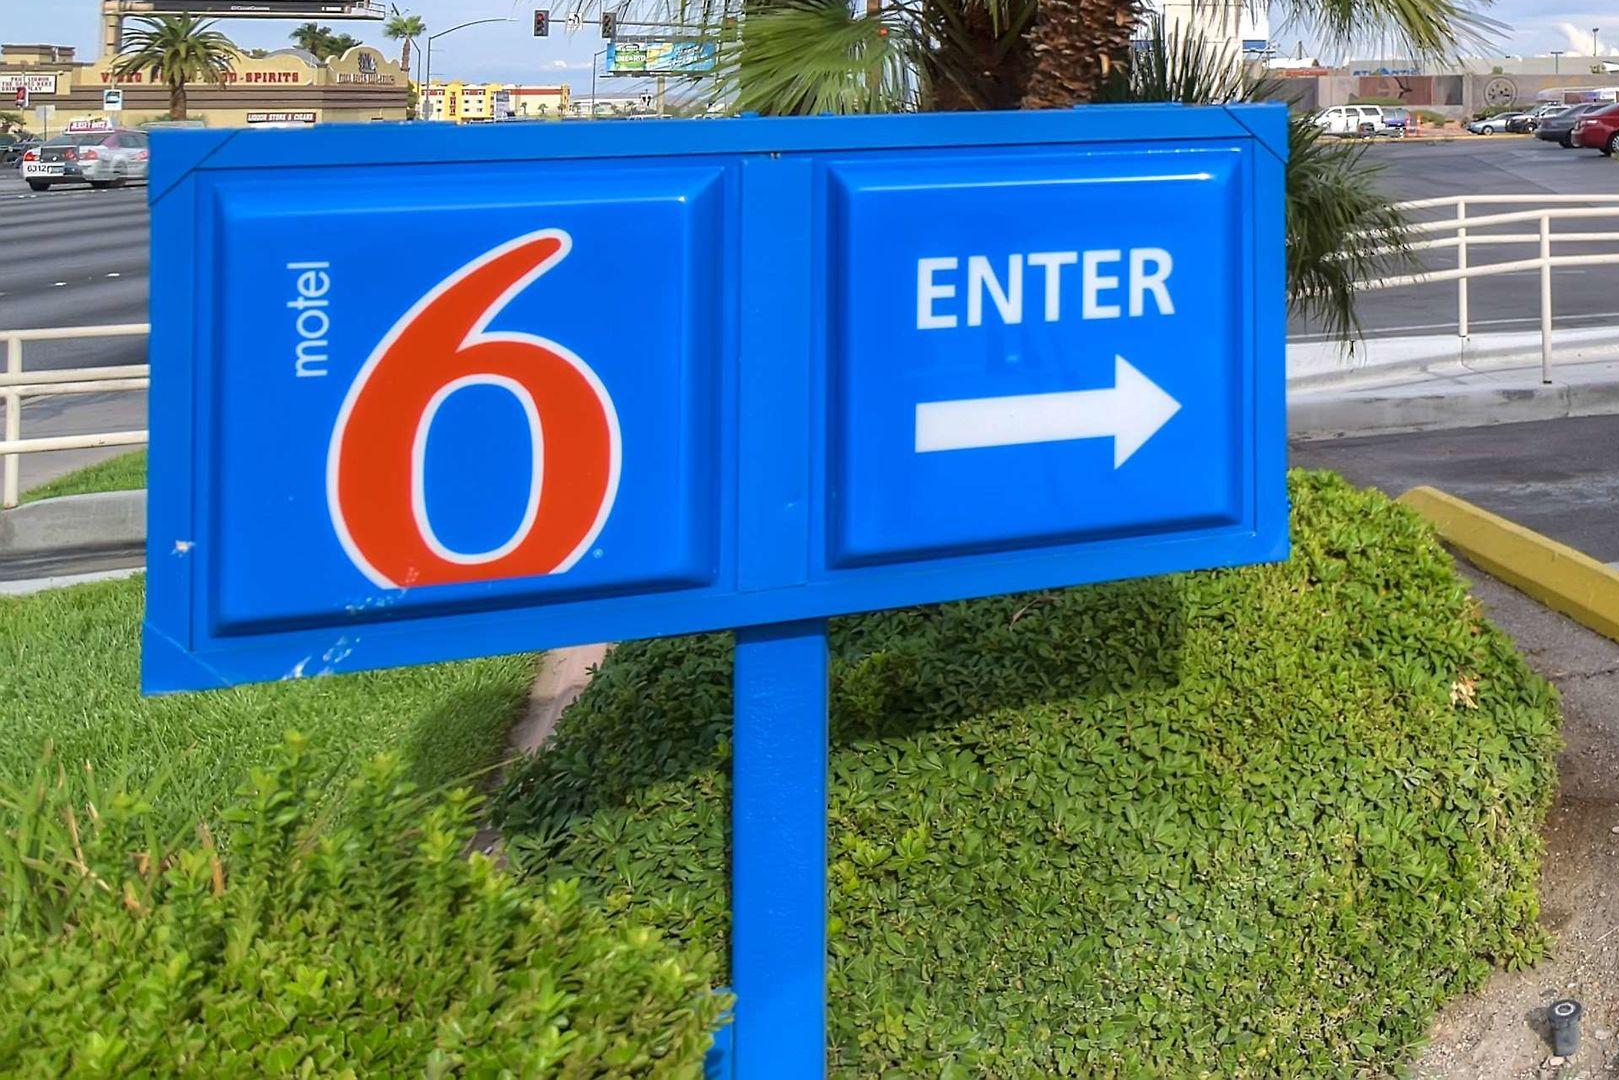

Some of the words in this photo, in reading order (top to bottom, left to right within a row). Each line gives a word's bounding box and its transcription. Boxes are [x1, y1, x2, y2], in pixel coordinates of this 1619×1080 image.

[245, 72, 300, 83] SPIRITS
[27, 165, 47, 173] 6312
[915, 246, 1176, 332] ENTER
[287, 260, 330, 379] motel
[326, 228, 623, 592] 6
